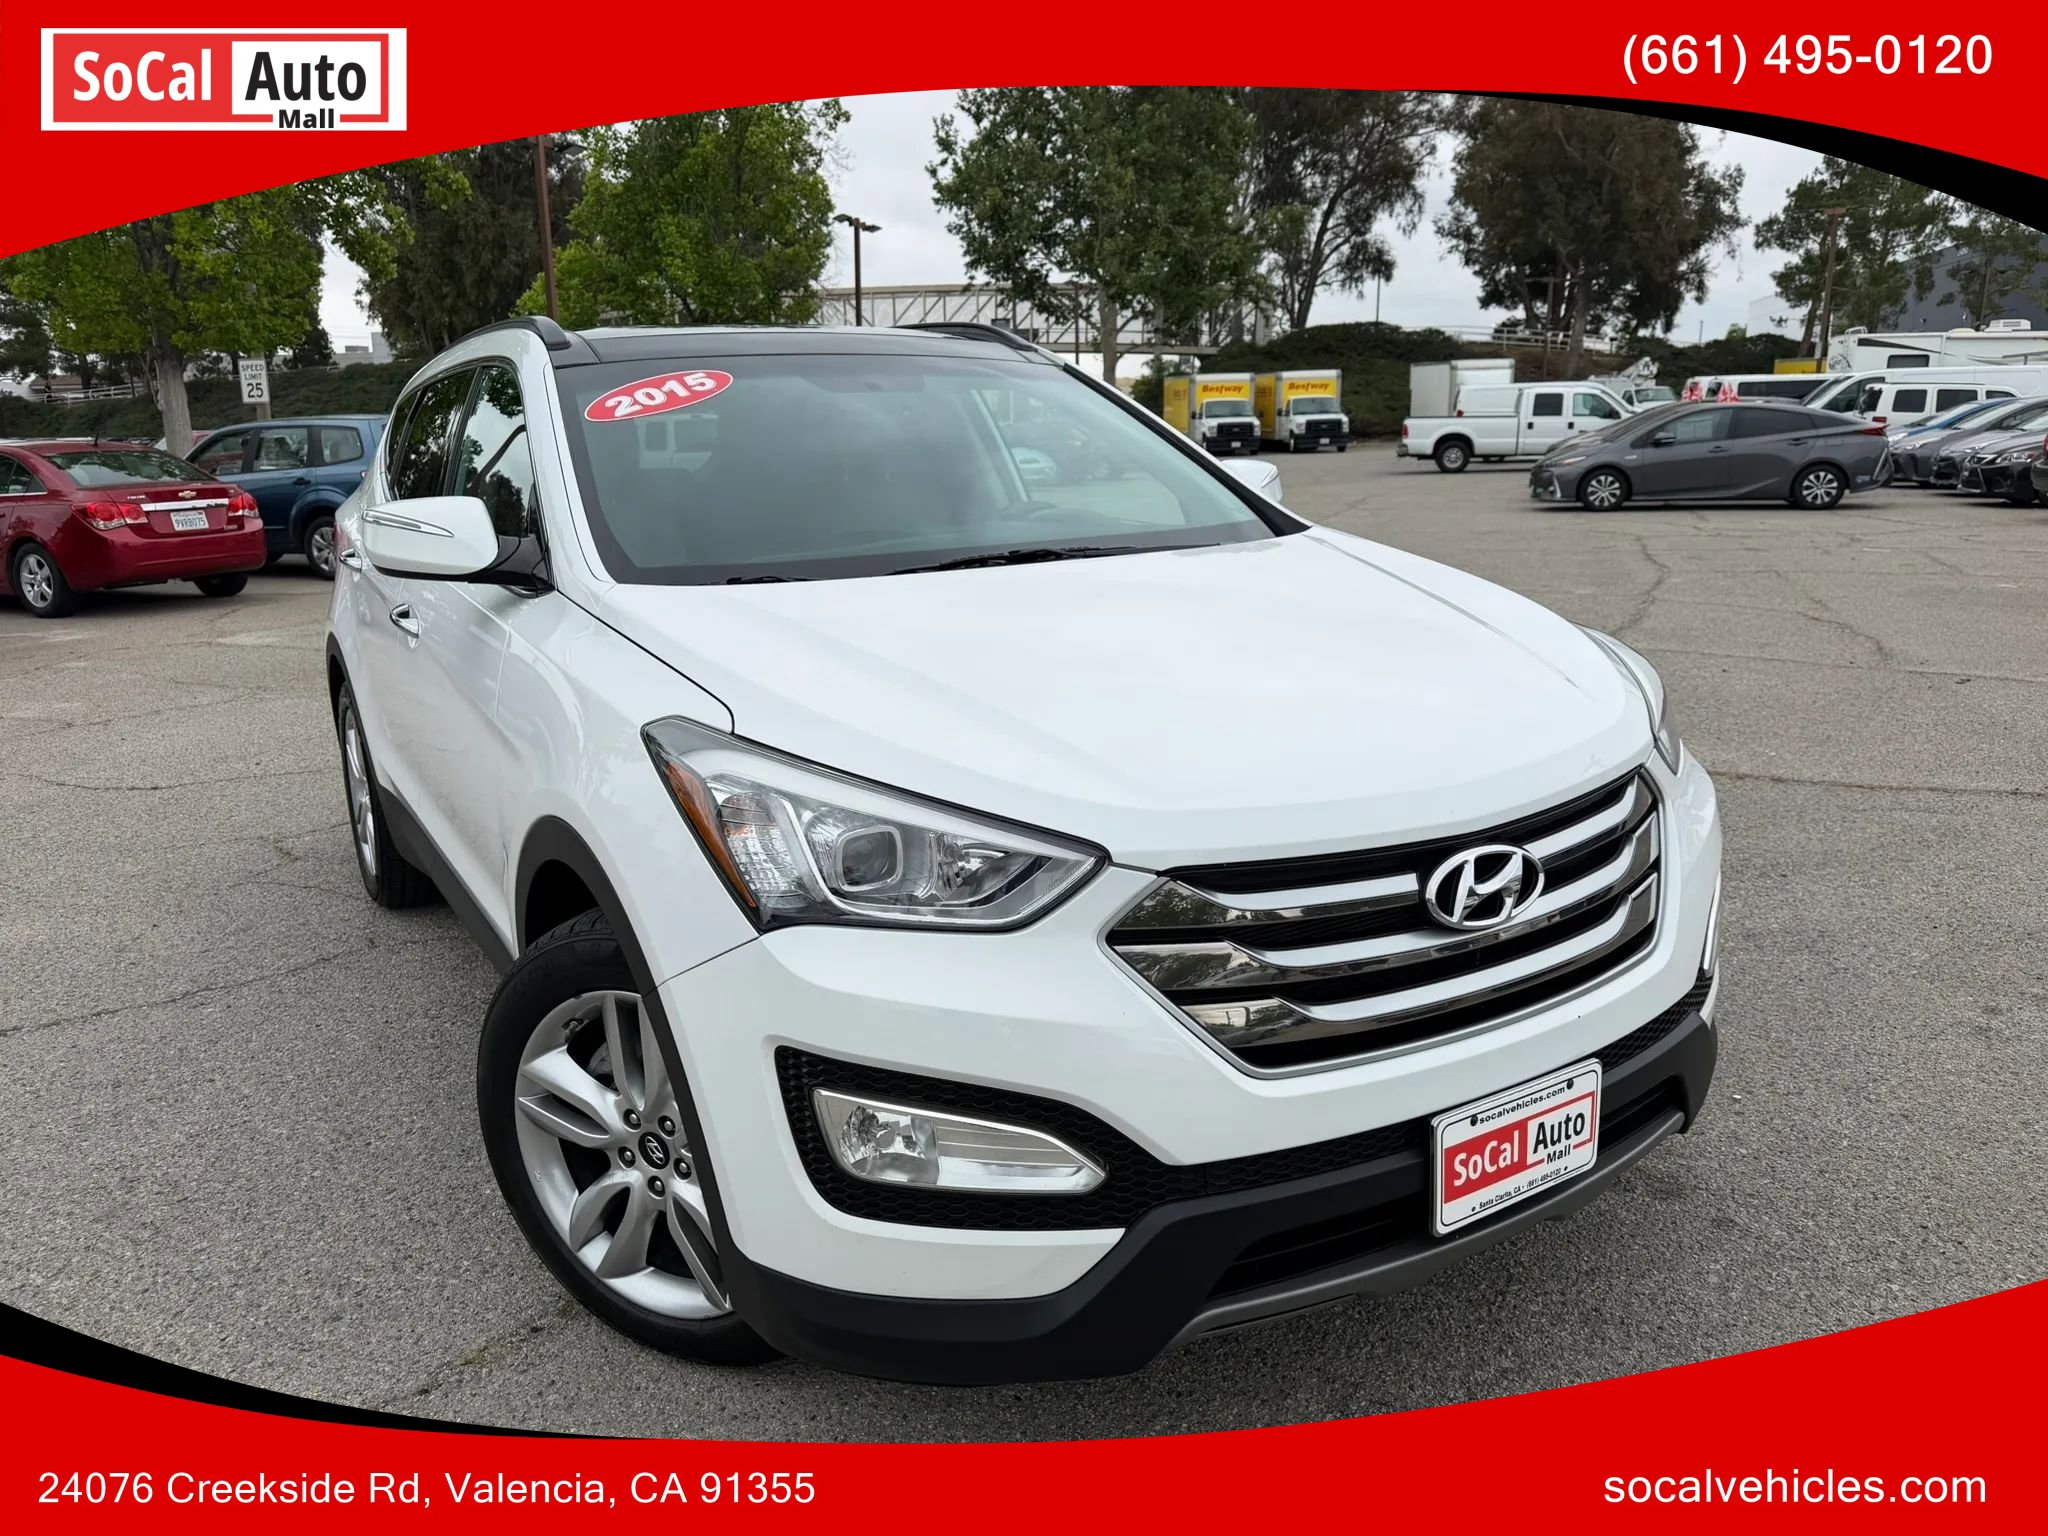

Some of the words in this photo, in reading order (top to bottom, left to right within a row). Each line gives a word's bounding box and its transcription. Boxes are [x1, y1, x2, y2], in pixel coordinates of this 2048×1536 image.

[241, 364, 264, 372] SPEED
[244, 373, 262, 381] LIMIT
[247, 382, 264, 398] 25
[604, 372, 717, 417] 2015
[1202, 384, 1244, 394] Bestway
[1479, 1086, 1566, 1125] socalvehicles.com
[1453, 1129, 1519, 1187] SoCal
[1532, 1112, 1586, 1155] Auto
[1546, 1143, 1571, 1165] Mall
[1479, 1199, 1494, 1210] Santa
[1513, 1185, 1521, 1194] CA
